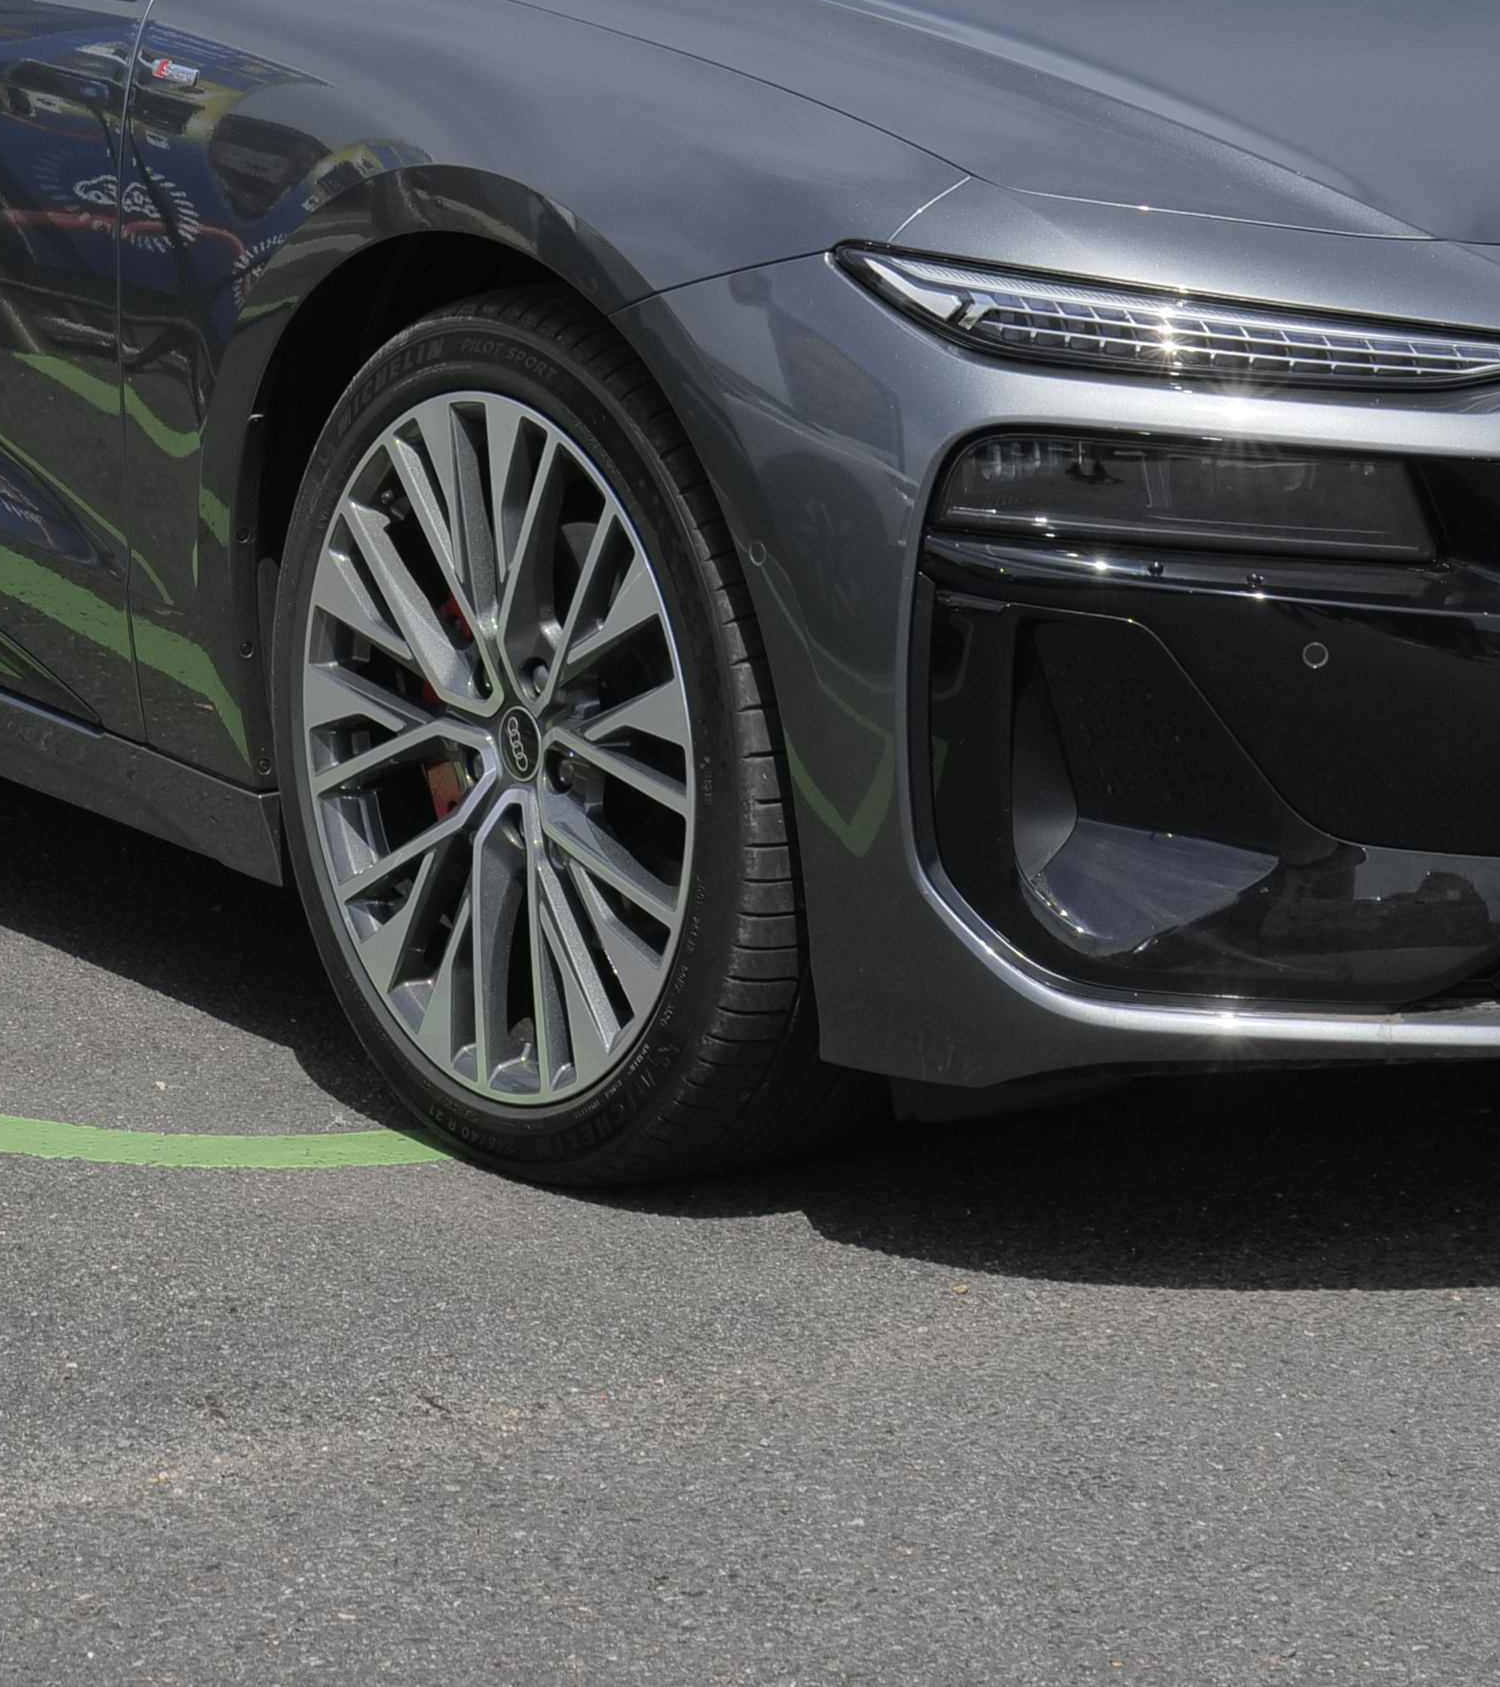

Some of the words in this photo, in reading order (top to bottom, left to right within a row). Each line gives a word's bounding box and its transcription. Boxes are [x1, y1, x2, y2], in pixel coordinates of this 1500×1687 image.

[337, 337, 446, 438] MICHELIN
[460, 337, 504, 358] PILOT
[505, 346, 559, 380] SPORT
